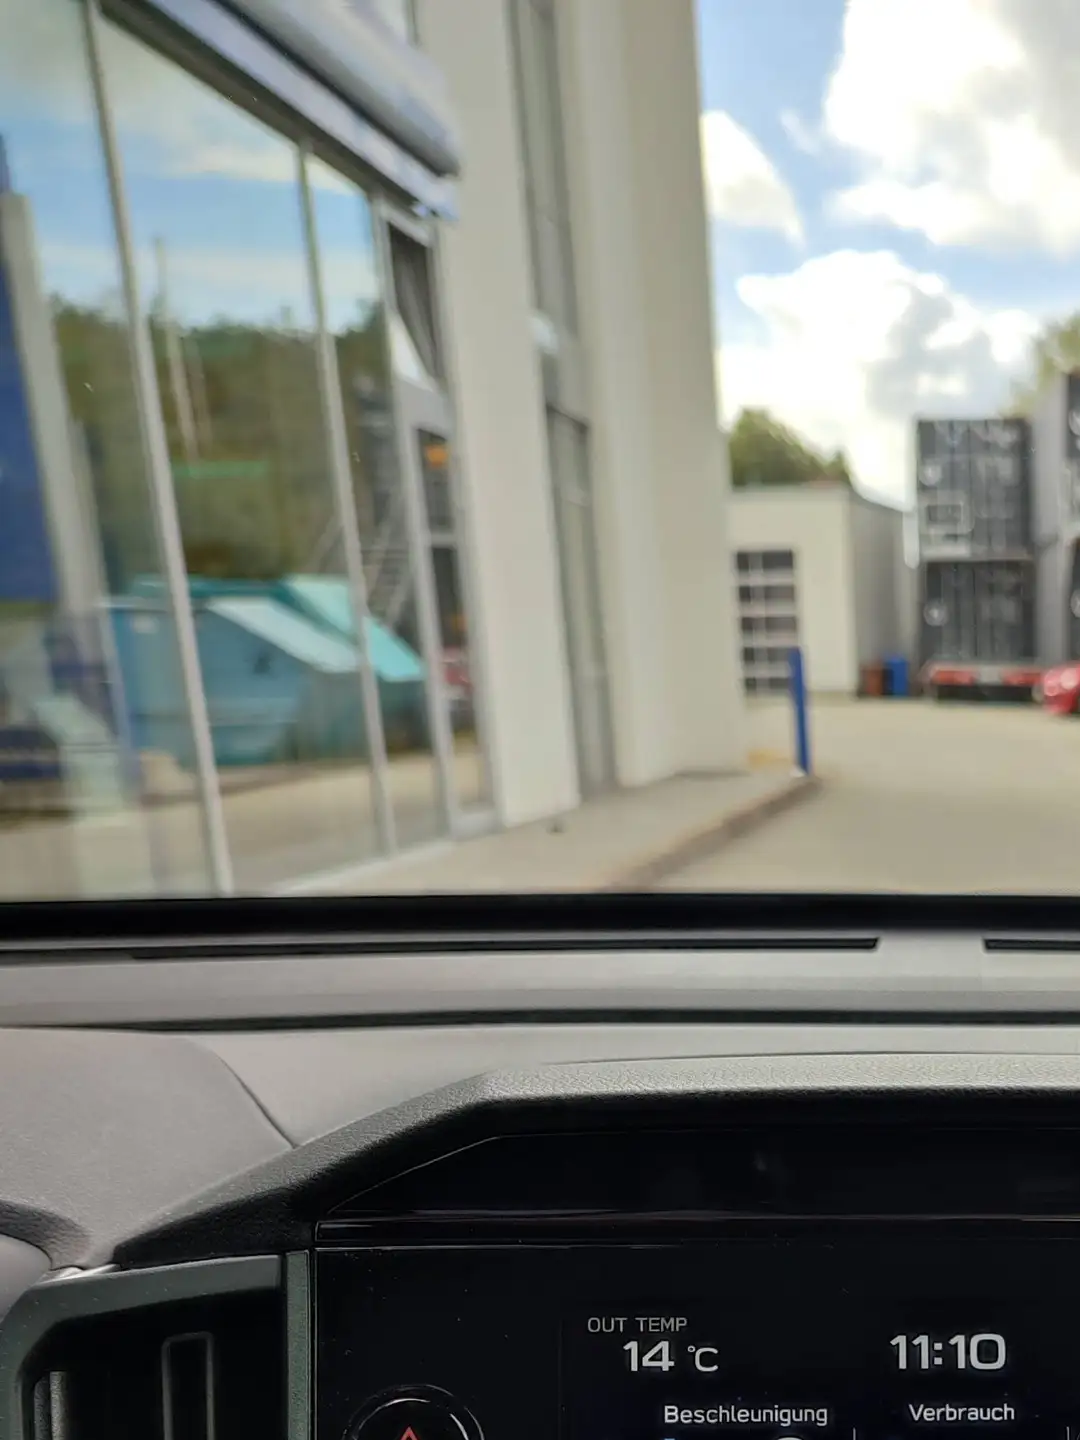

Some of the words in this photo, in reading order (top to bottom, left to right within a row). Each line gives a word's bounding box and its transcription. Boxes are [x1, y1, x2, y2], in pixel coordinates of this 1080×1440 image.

[587, 1317, 628, 1333] OUT
[635, 1317, 688, 1332] TEMP
[623, 1340, 675, 1372] 14
[890, 1333, 1006, 1370] 11:10
[664, 1405, 828, 1426] Beschleunigung
[909, 1403, 1015, 1421] Verbrauch
